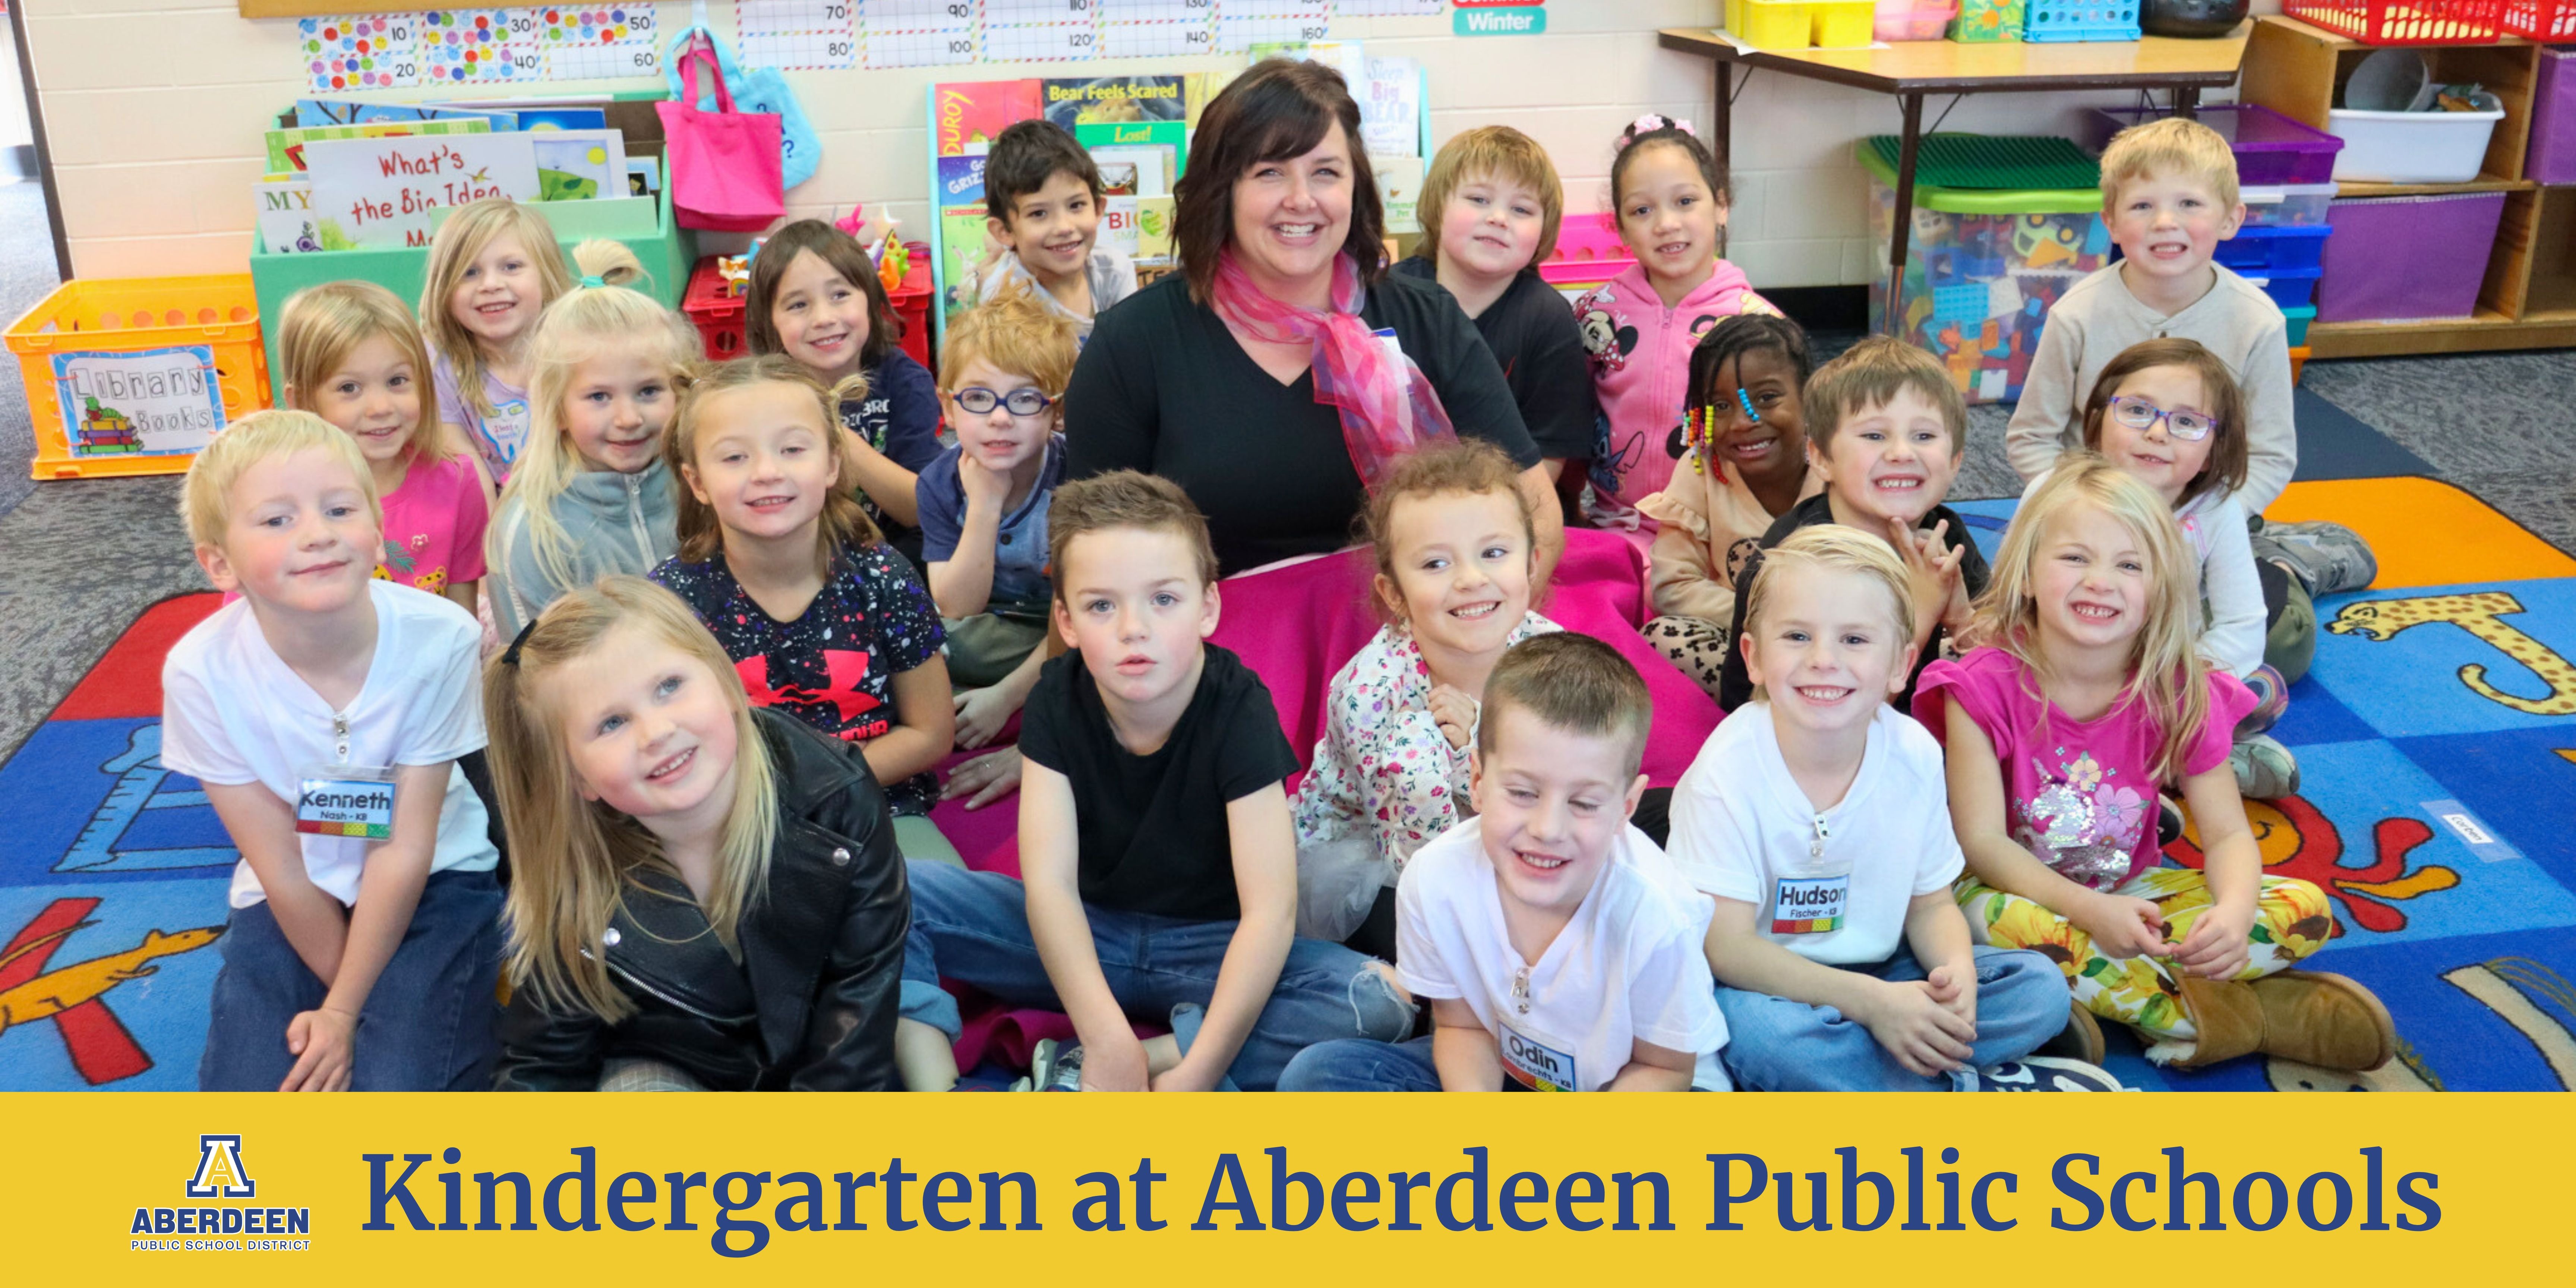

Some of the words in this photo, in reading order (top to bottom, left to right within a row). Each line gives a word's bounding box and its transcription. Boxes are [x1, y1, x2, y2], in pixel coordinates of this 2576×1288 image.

[948, 4, 968, 18] 90
[1070, 0, 1087, 11] 110
[826, 6, 845, 19] 70
[511, 19, 531, 32] 30
[630, 16, 650, 29] 50
[1467, 12, 1534, 31] Winter
[391, 27, 406, 41] 10
[1187, 31, 1208, 44] 140
[1302, 27, 1323, 39] 160
[1069, 34, 1091, 47] 120
[828, 43, 848, 56] 80
[949, 41, 971, 54] 100
[515, 56, 536, 69] 40
[634, 53, 654, 66] 60
[396, 64, 415, 77] 20
[1049, 85, 1082, 101] Bear
[1087, 86, 1124, 100] Feels
[1127, 83, 1177, 100] Scared
[1114, 127, 1151, 142] Lost!
[378, 144, 464, 177] What's
[264, 190, 312, 211] MY
[351, 198, 393, 225] the
[1109, 211, 1139, 230] BI
[73, 368, 205, 398] Library
[137, 408, 214, 433] Books
[301, 790, 391, 810] Kenneth
[321, 811, 347, 820] Nash
[1779, 886, 1846, 906] Hudson
[1790, 908, 1821, 918] Fischer
[1509, 1035, 1559, 1074] Odin
